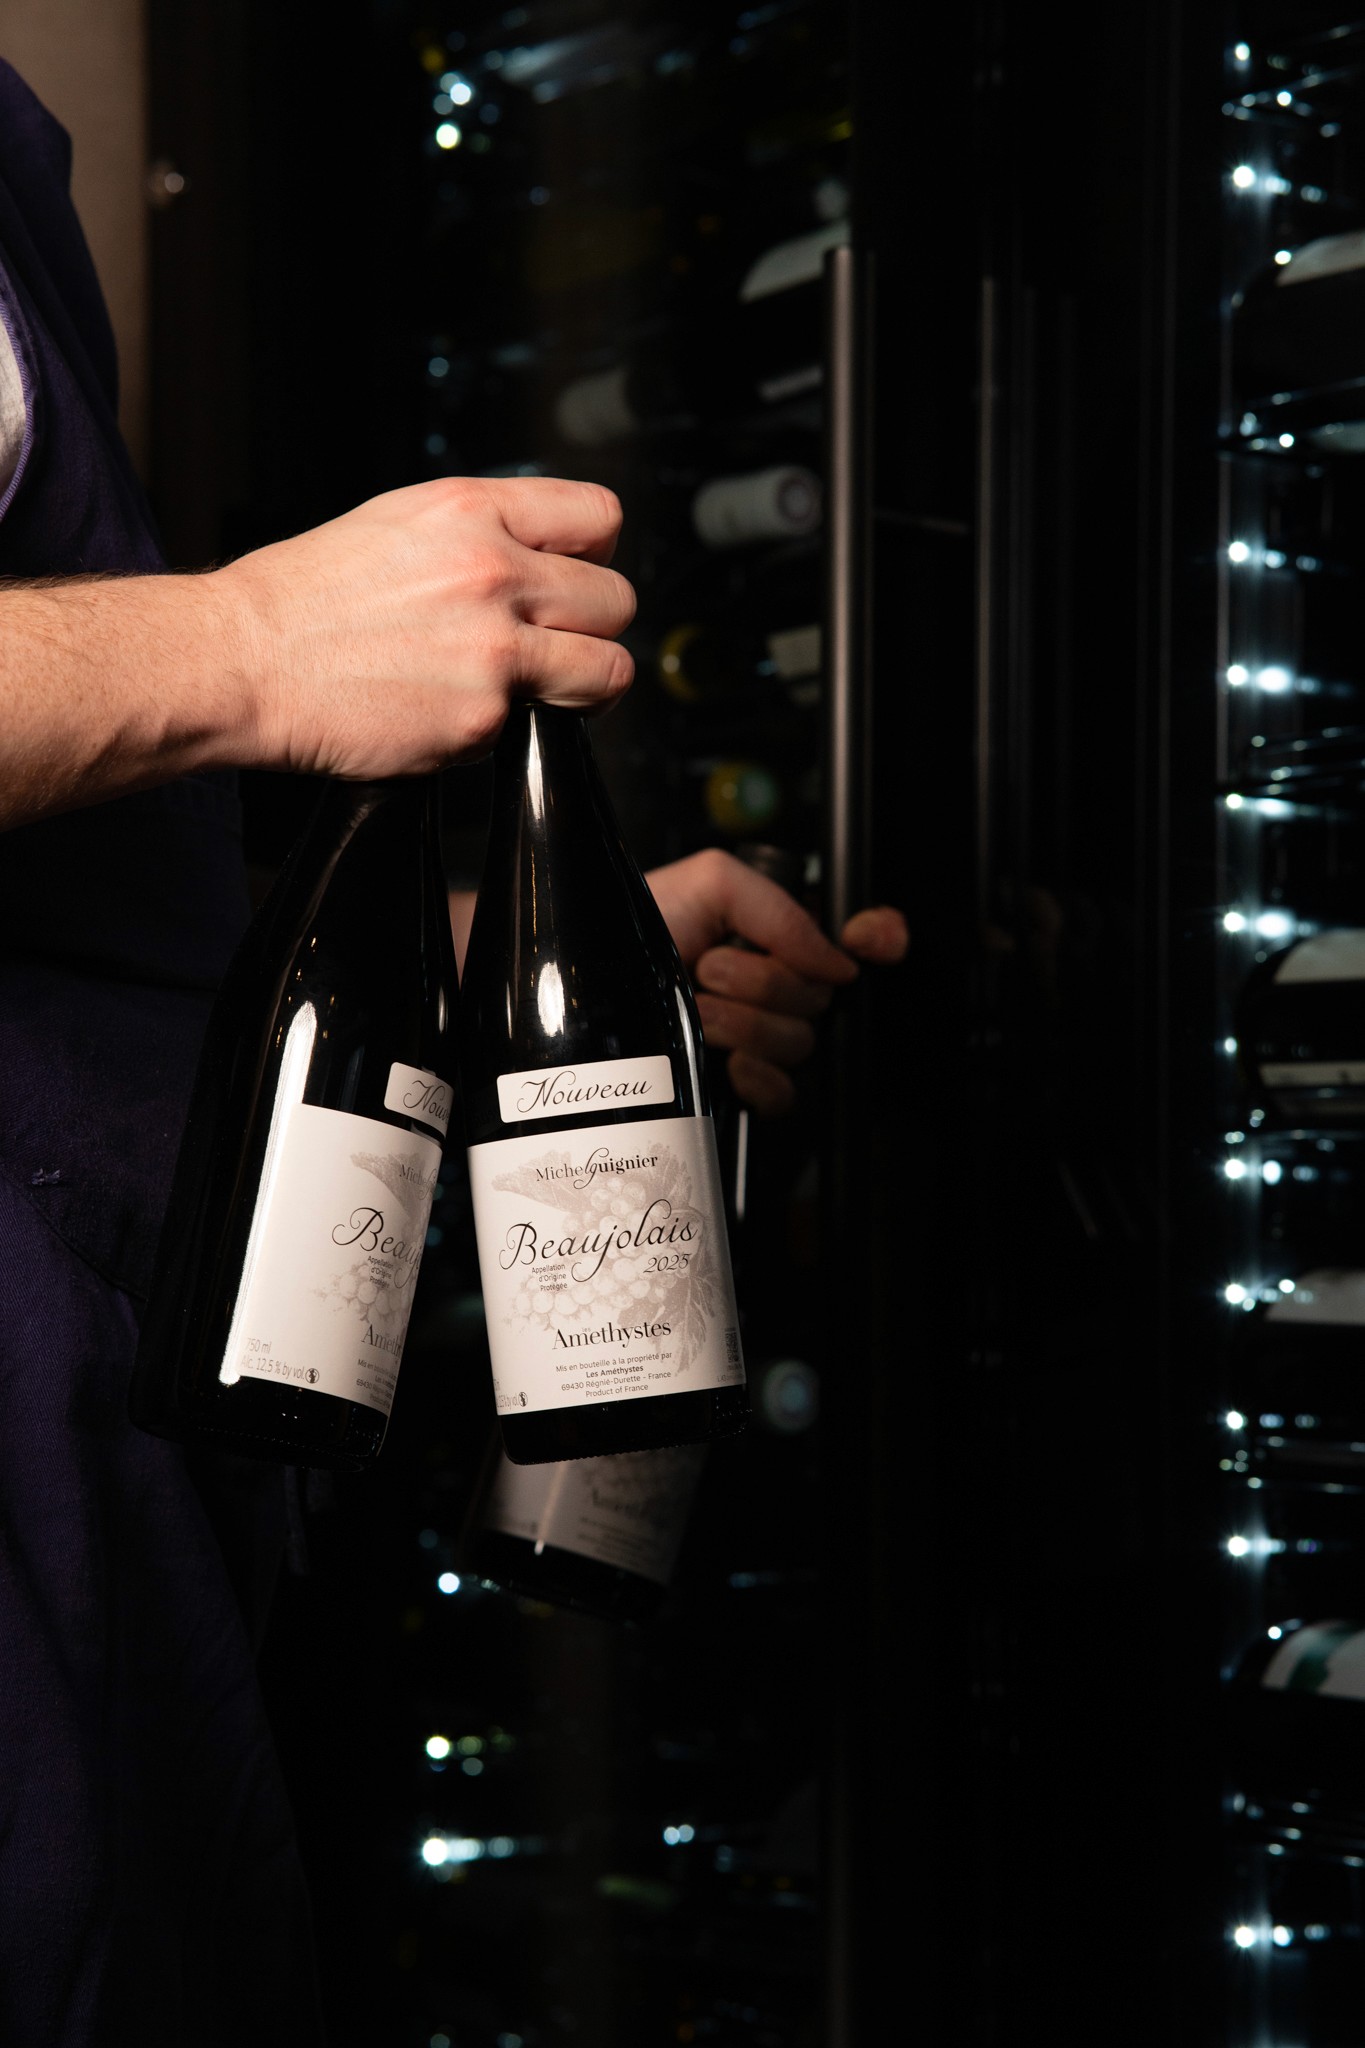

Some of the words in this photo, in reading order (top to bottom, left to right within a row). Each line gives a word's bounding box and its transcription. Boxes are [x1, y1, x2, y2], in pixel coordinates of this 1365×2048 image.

[517, 1070, 653, 1113] Nouveau
[499, 1199, 698, 1282] Beaujolais
[531, 1263, 566, 1275] Appellation
[643, 1253, 692, 1273] 2025
[538, 1273, 567, 1282] d'Origine
[246, 1337, 261, 1352] 750
[261, 1341, 272, 1354] ml
[579, 1359, 610, 1370] bouteille
[627, 1352, 660, 1364] propriété
[661, 1352, 672, 1362] par
[283, 1362, 293, 1380] by
[600, 1365, 644, 1377] Améthystes
[561, 1381, 584, 1391] 69430
[648, 1371, 672, 1380] France
[585, 1388, 613, 1398] Product
[615, 1385, 623, 1393] of
[624, 1384, 649, 1393] France
